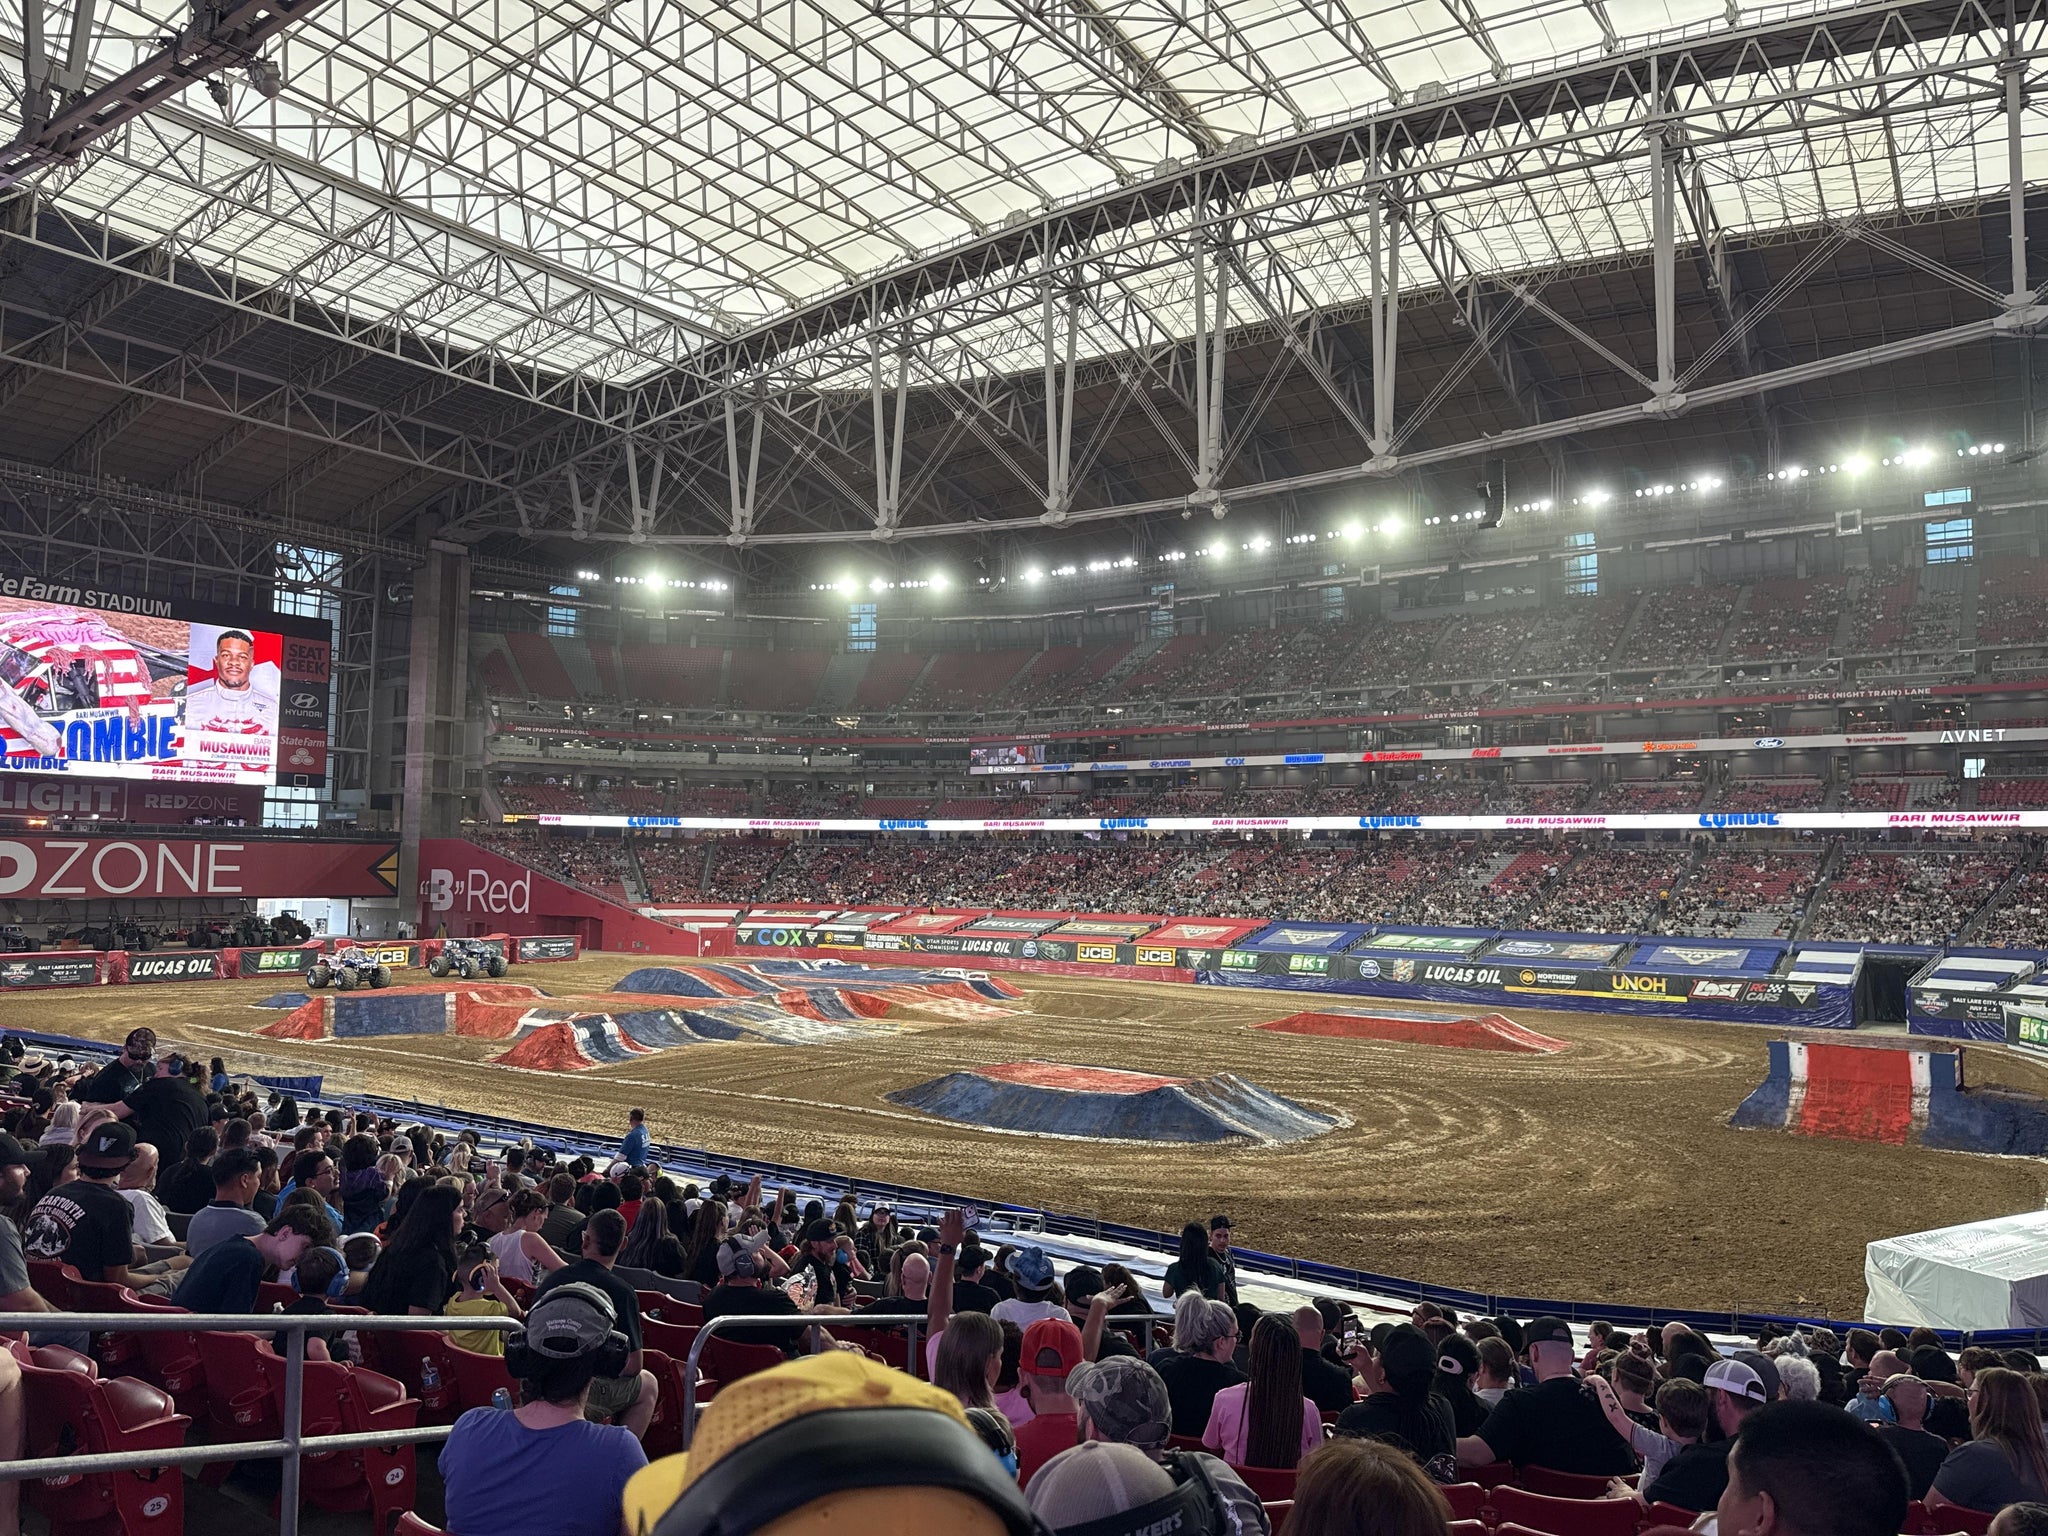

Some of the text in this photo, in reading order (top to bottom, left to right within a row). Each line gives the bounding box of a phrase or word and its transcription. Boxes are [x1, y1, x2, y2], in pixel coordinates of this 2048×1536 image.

[84, 590, 172, 617] STADIUM
[289, 644, 325, 660] SEAT
[287, 659, 325, 675] GEEK
[1807, 692, 1830, 700] DICK
[1832, 690, 1866, 699] (NIGHT
[1869, 689, 1902, 698] TRAIN)
[285, 708, 323, 718] HYUNDAI
[1940, 729, 2006, 743] AVNET
[200, 740, 270, 756] MUSAWWIR
[151, 768, 237, 778] BARI MUSAWWIR
[145, 793, 238, 812] REDZONE
[1889, 813, 2021, 822] BARI MUSAWWIR
[467, 869, 531, 913] Red
[758, 929, 803, 946] COX
[961, 940, 992, 952] LUCAS
[994, 941, 1010, 953] OIL
[1080, 947, 1113, 959] JCB
[260, 952, 301, 968] BKT
[1139, 950, 1173, 962] JCB
[1221, 952, 1258, 967] BKT
[1289, 956, 1328, 970] BKT
[132, 959, 212, 976] LUCAS OIL
[1425, 966, 1475, 982] LUCAS
[1477, 969, 1501, 984] OIL
[1537, 973, 1577, 981] NORTHERN
[1612, 974, 1667, 992] UNOH
[1750, 983, 1769, 992] RC
[1746, 992, 1781, 1002] CARS
[390, 1473, 400, 1481] 24
[150, 1501, 162, 1512] 25
